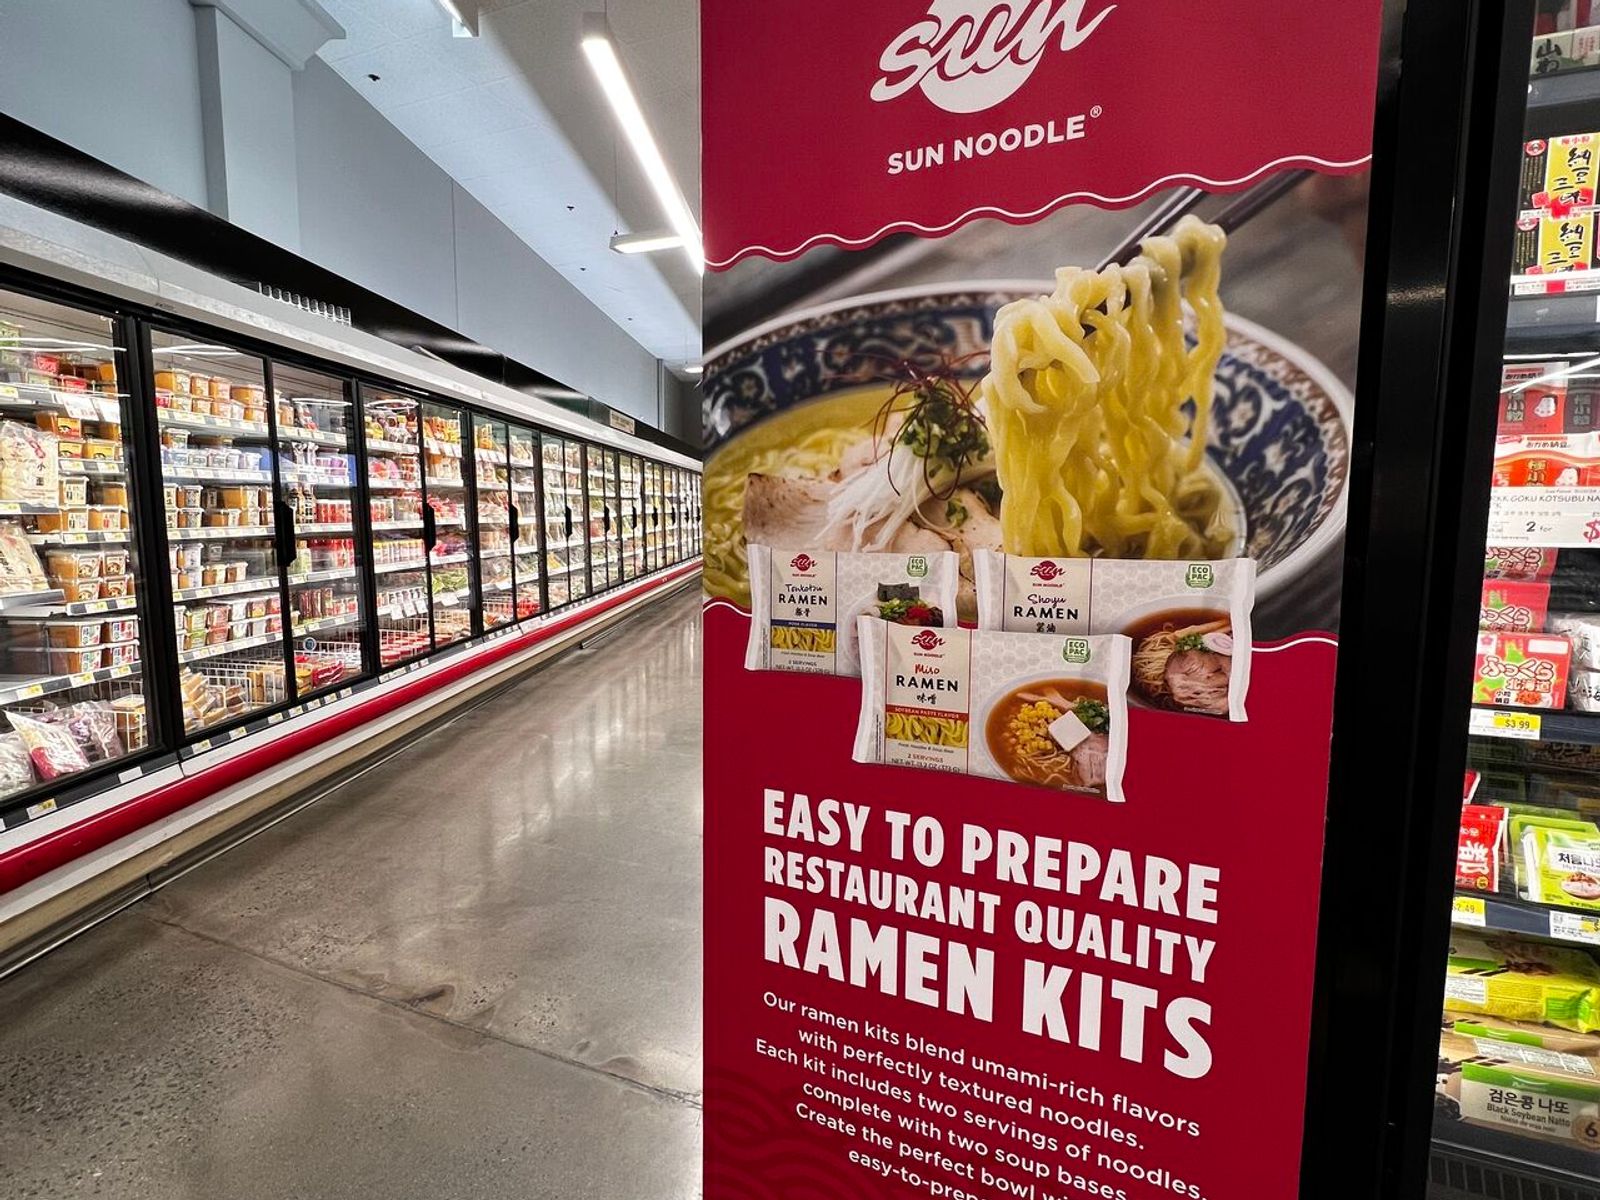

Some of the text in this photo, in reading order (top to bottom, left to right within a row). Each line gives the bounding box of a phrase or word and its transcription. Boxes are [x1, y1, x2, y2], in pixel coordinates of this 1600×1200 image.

[888, 144, 944, 175] SUN
[1526, 521, 1536, 532] 2
[778, 593, 828, 606] RAMEN
[1013, 605, 1079, 620] RAMEN
[1027, 593, 1067, 608] Shoyu
[896, 675, 959, 692] RAMEN
[915, 663, 940, 675] Miso
[764, 788, 1220, 924] EASY TO PREPARE
[764, 846, 1217, 984] RESTAURANT QUALITY
[764, 896, 1213, 1079] RAMEN KITS
[763, 991, 1200, 1137] Our ramen kits blend umami-rich flavors
[756, 1038, 798, 1065] Each
[803, 1053, 826, 1075] kit
[831, 1063, 912, 1104] includes
[917, 1092, 958, 1118] two
[963, 1110, 1058, 1152] servings
[1065, 1142, 1092, 1161] of
[798, 1029, 1145, 1149] with perfectly textured noodles.
[1488, 1088, 1571, 1114] 검은콩 나또
[803, 1082, 892, 1123] complete
[897, 1114, 941, 1141] with
[947, 1129, 989, 1156] two
[994, 1148, 1050, 1179] soup
[1486, 1103, 1571, 1128] Black Soybean Natto
[796, 1102, 1035, 1200] Create the perfect bowl
